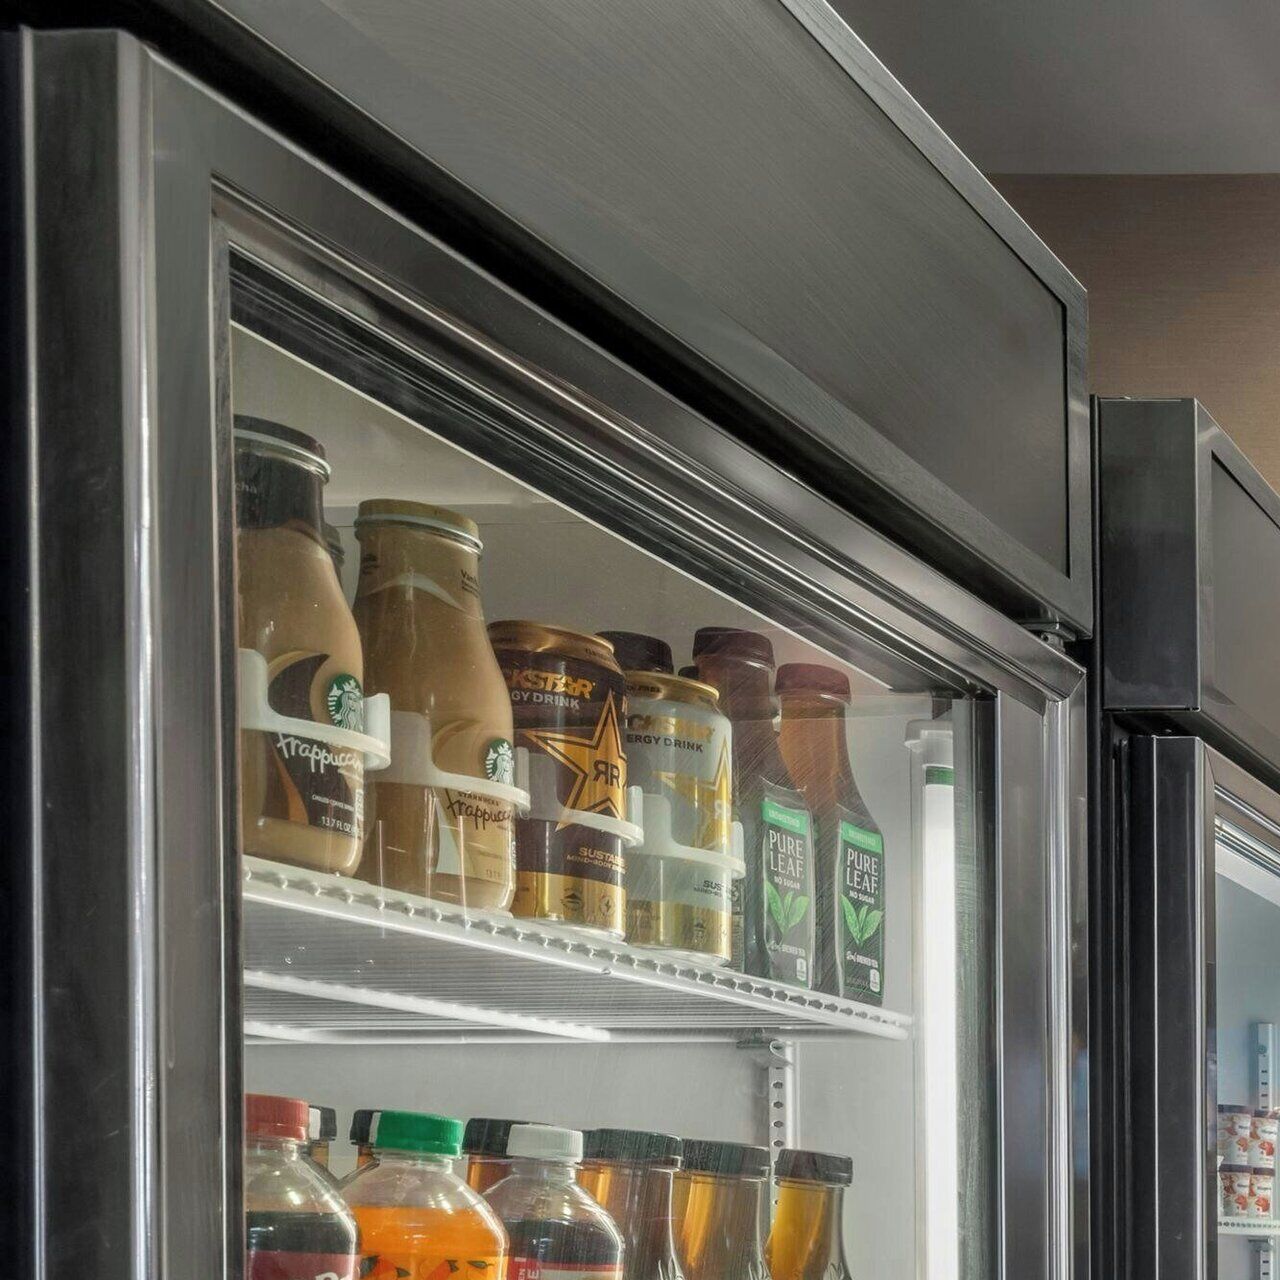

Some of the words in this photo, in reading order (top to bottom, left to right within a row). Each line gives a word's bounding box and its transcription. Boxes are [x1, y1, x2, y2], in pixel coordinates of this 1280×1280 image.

[535, 692, 580, 710] DRINK
[626, 733, 661, 746] ERGY
[663, 737, 704, 753] DRINK
[769, 829, 804, 860] PURE
[847, 848, 879, 876] PURE
[858, 893, 875, 905] SUGAR
